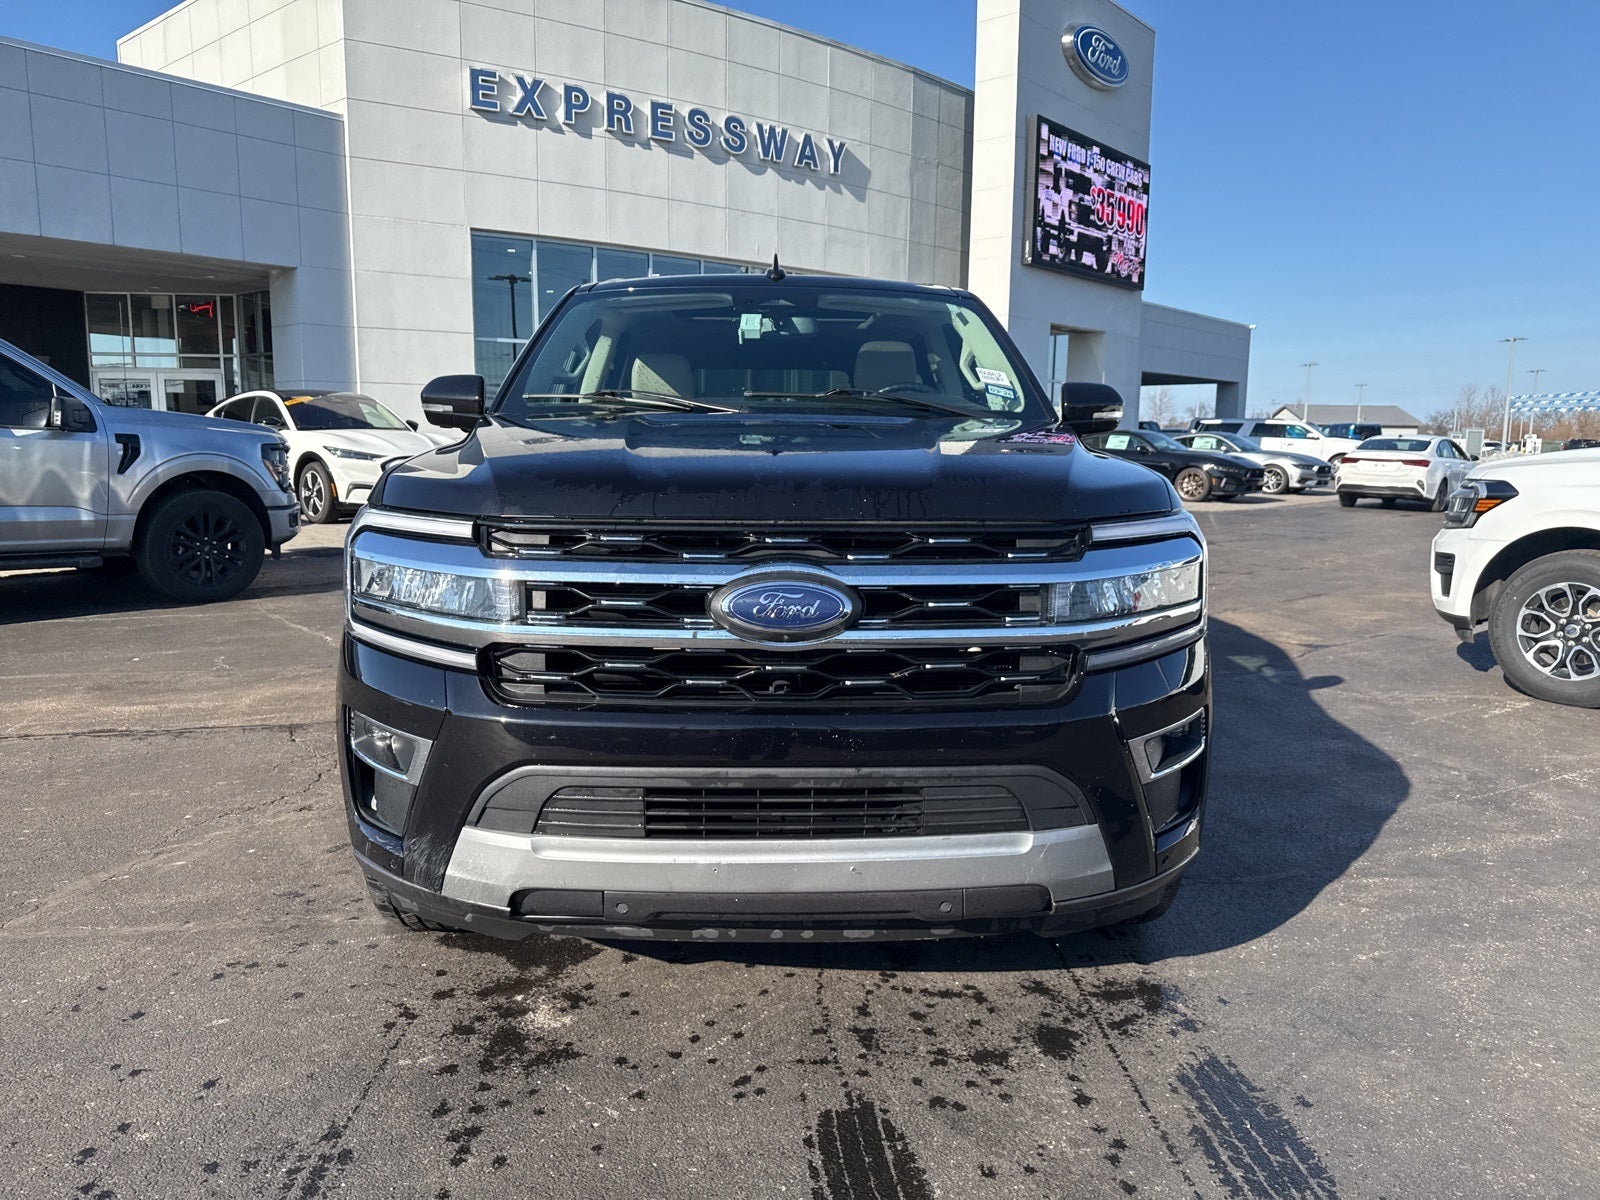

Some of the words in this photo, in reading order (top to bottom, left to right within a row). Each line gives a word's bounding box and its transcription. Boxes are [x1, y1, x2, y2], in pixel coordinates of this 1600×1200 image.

[1087, 34, 1121, 76] Ford
[468, 65, 847, 175] EXPRESSWAY
[1049, 133, 1067, 157] NEW
[1067, 142, 1086, 164] FORD
[1086, 149, 1106, 172] F-150
[1106, 158, 1126, 180] CREW
[1126, 167, 1144, 188] CABS
[752, 591, 821, 619] Ford
